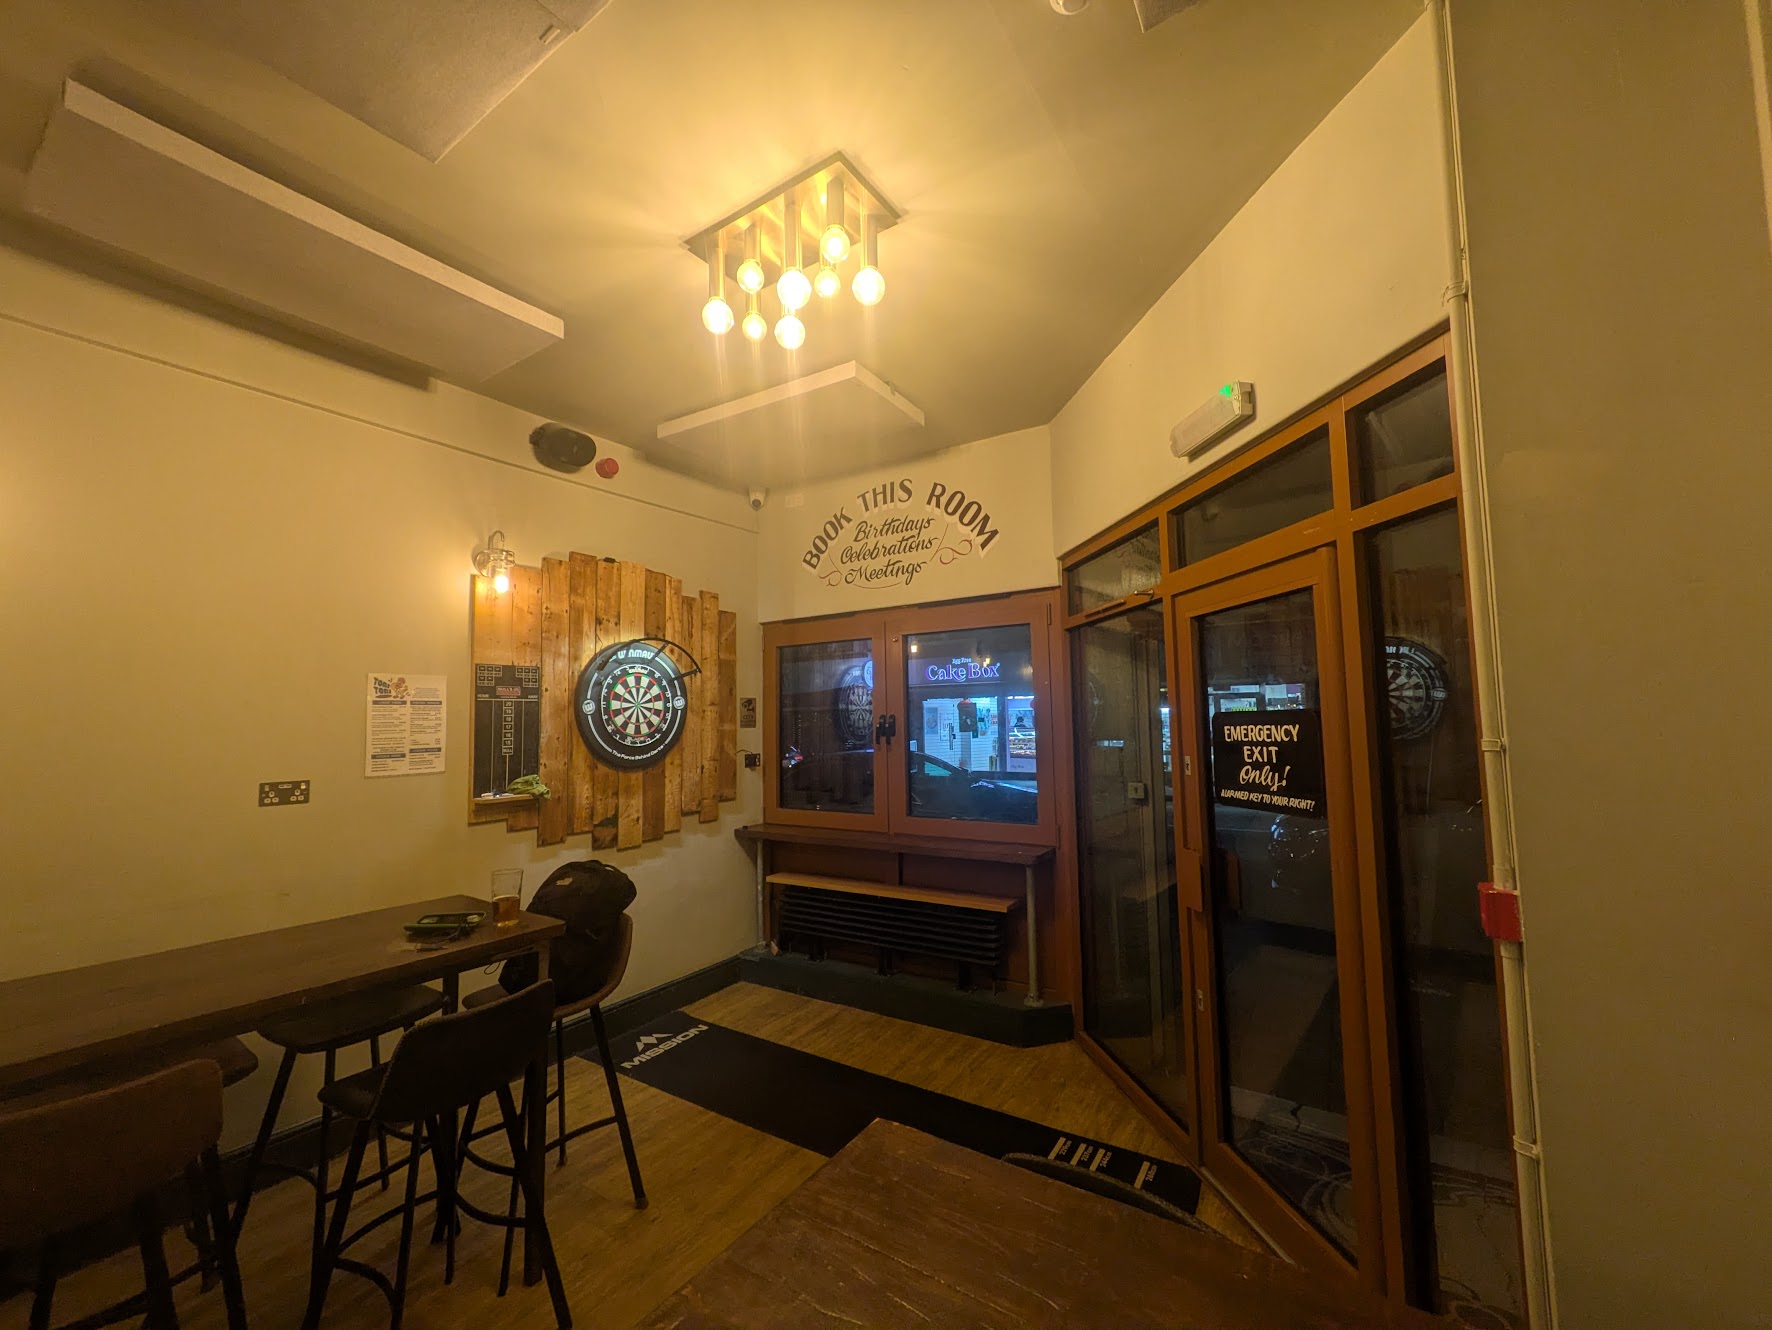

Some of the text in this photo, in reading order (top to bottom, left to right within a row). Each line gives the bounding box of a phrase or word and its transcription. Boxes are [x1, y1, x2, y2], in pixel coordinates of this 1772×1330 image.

[802, 478, 1000, 571] BOOK THIS ROOM
[853, 515, 936, 543] Birthdays
[840, 532, 940, 565] Celebrations
[844, 560, 929, 586] Meetings
[925, 662, 1000, 682] Cake Box
[1223, 724, 1300, 743] EMERGENCY
[1243, 745, 1279, 764] EXIT
[1239, 765, 1292, 792] Only!
[1220, 788, 1316, 812] ALARMED KEY TO YOUR RIGHT!
[620, 1024, 709, 1069] MISSION
